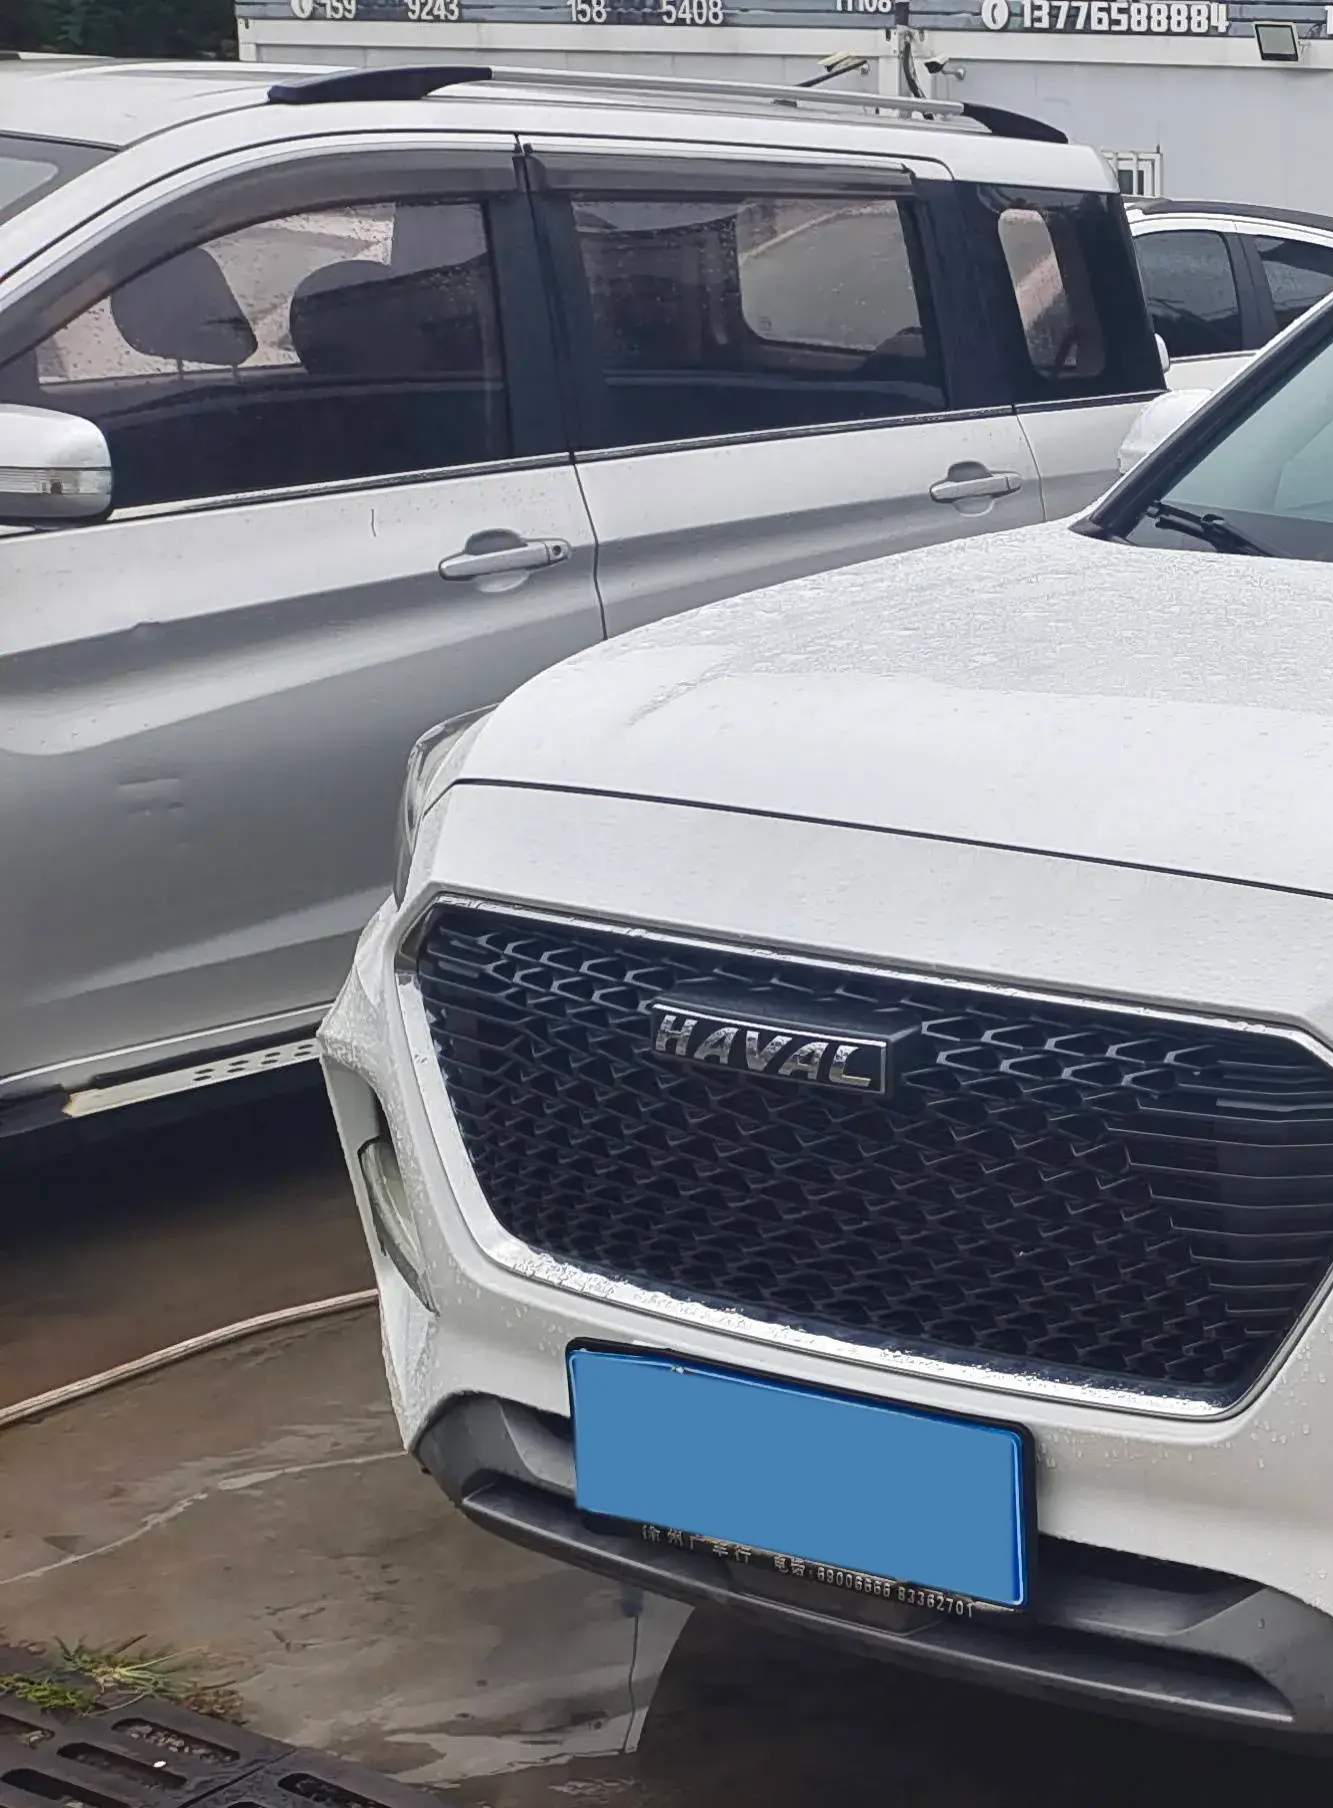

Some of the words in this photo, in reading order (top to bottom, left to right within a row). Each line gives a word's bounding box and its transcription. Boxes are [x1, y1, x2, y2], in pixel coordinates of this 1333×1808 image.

[661, 0, 725, 25] 5408
[1023, 0, 1230, 33] 13776588884
[654, 1014, 872, 1087] HAVAL
